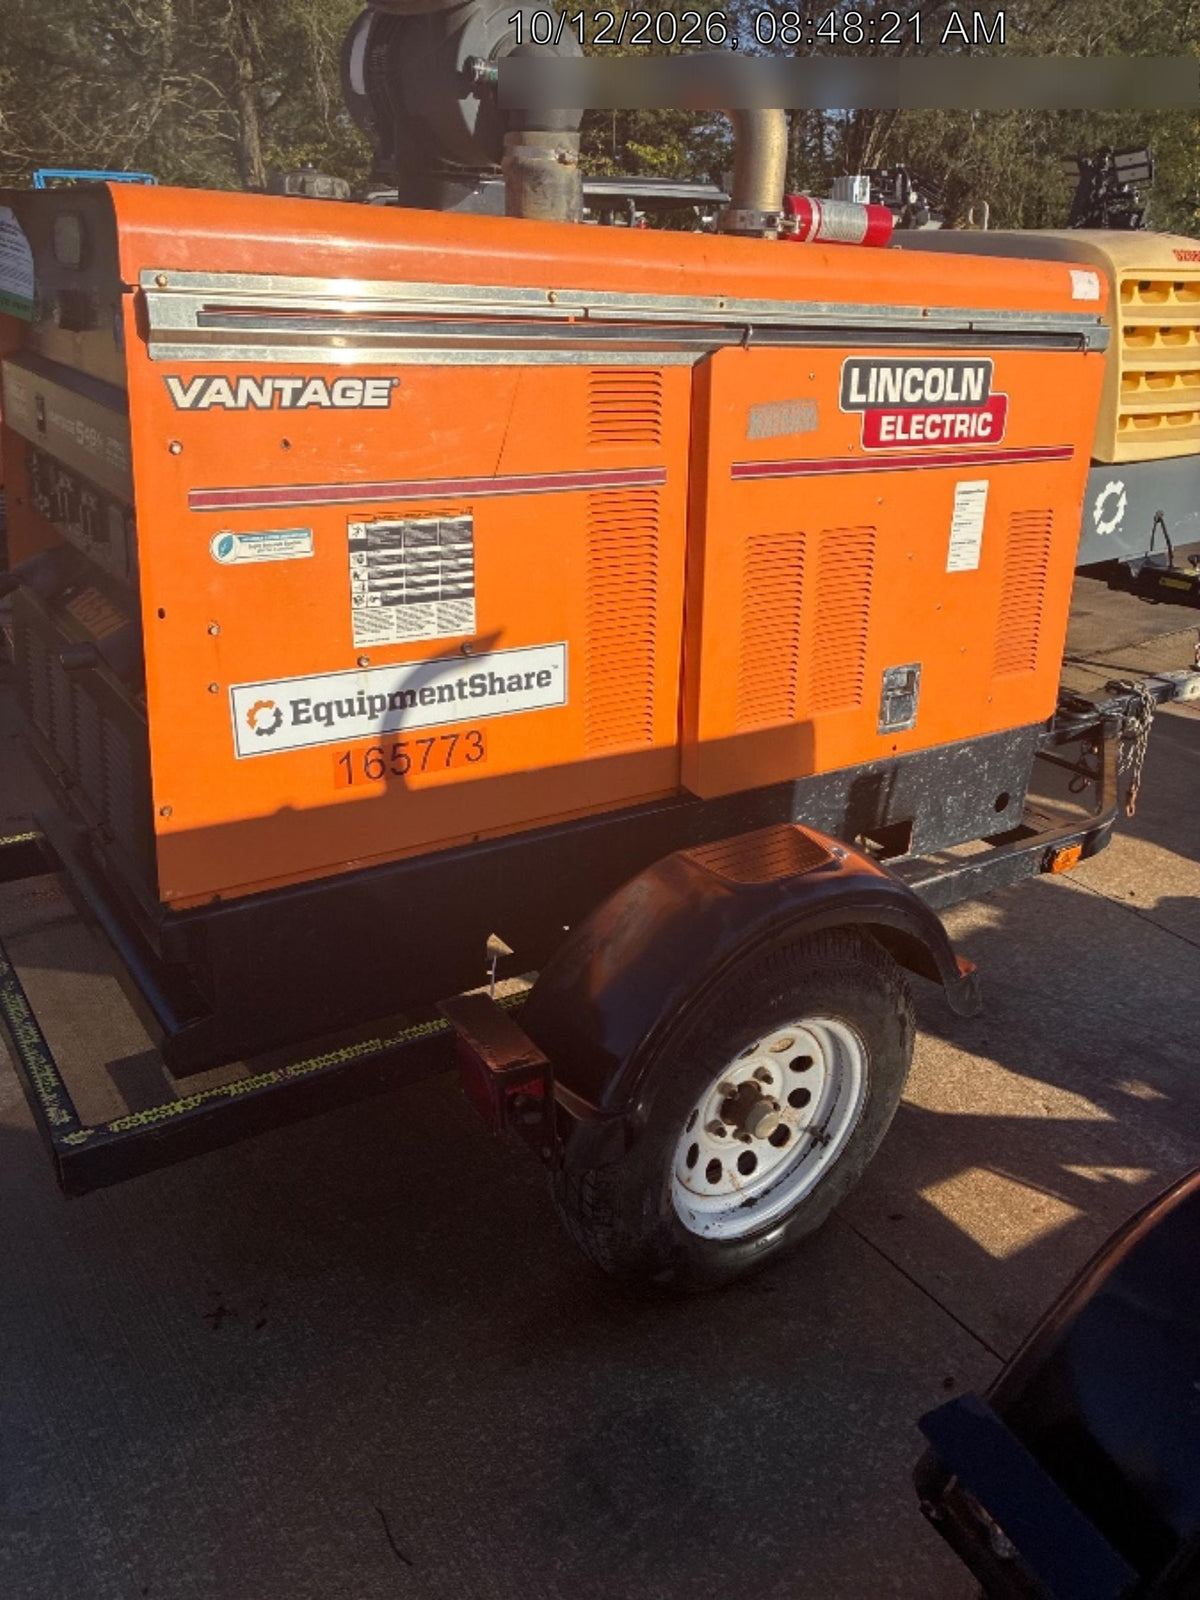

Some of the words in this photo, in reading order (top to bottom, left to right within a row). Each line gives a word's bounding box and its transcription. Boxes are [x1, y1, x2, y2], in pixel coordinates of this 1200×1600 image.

[163, 375, 393, 410] VANTAGE
[849, 367, 986, 404] LINCOLN
[879, 412, 993, 442] ELECTRIC
[290, 666, 554, 728] EquipmentShare
[337, 729, 485, 785] 165773
